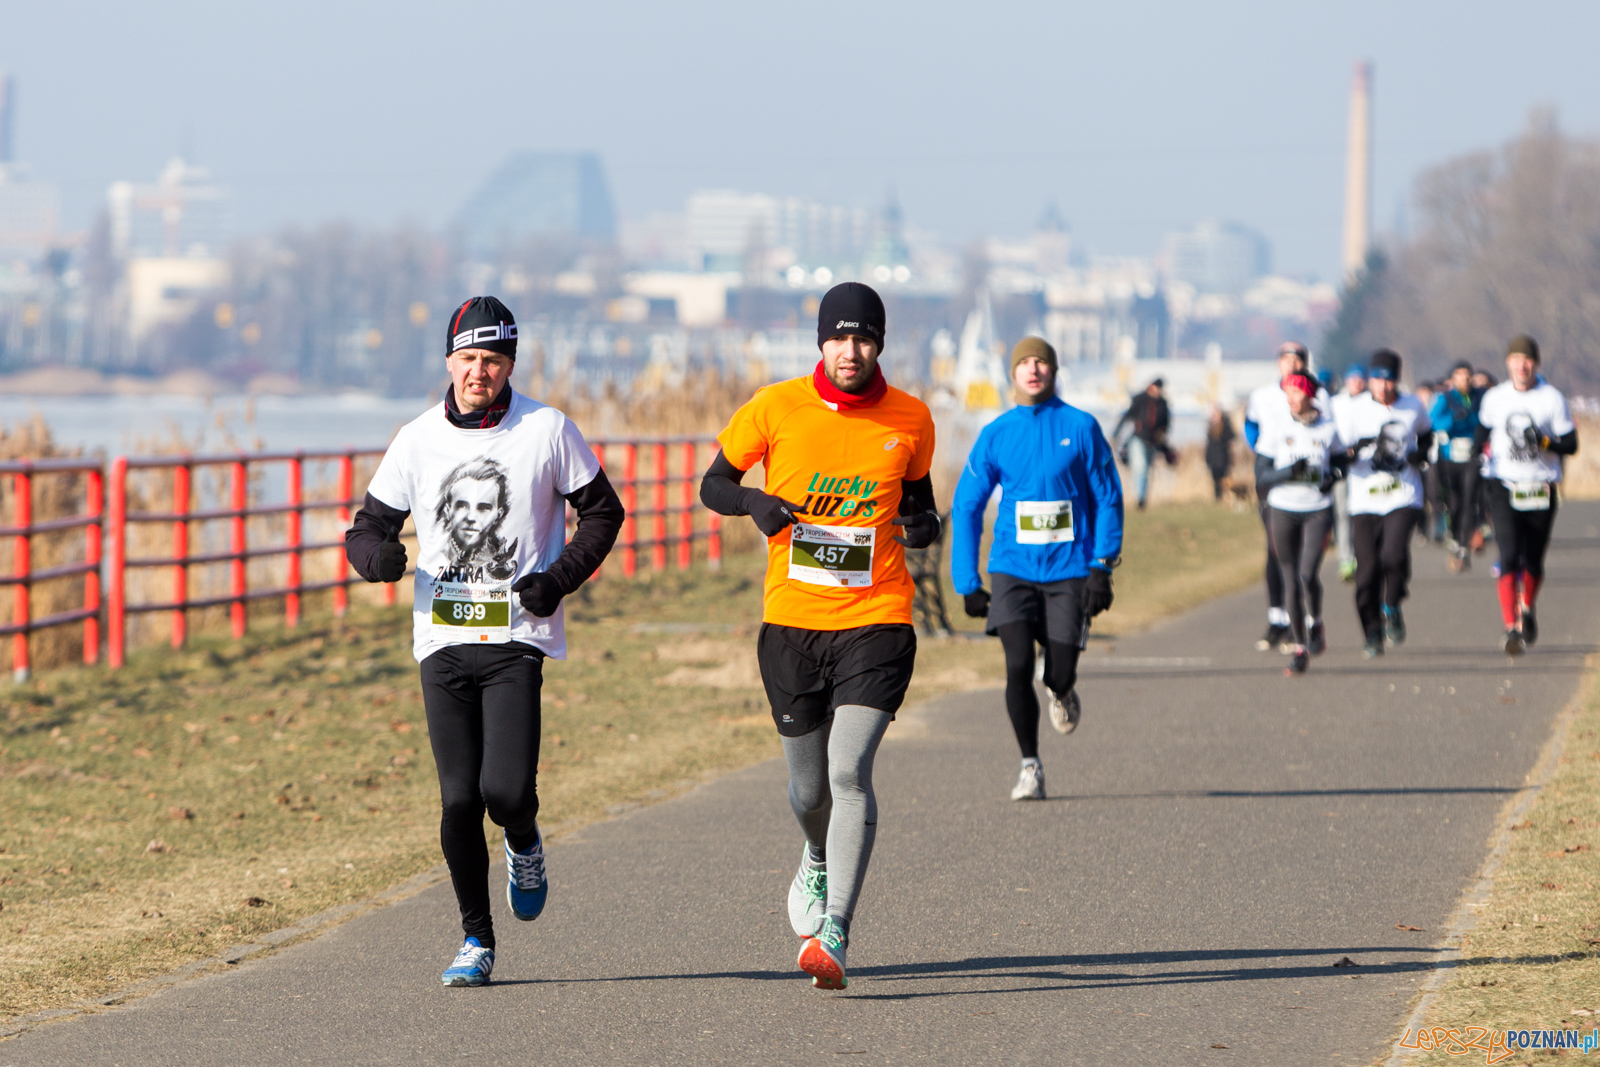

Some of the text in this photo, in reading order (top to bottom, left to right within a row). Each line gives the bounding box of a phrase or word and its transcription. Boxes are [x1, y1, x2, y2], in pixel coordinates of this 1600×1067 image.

[806, 472, 879, 499] Lucky
[800, 495, 878, 518] LUZers
[814, 546, 849, 563] 457
[453, 603, 486, 620] 899
